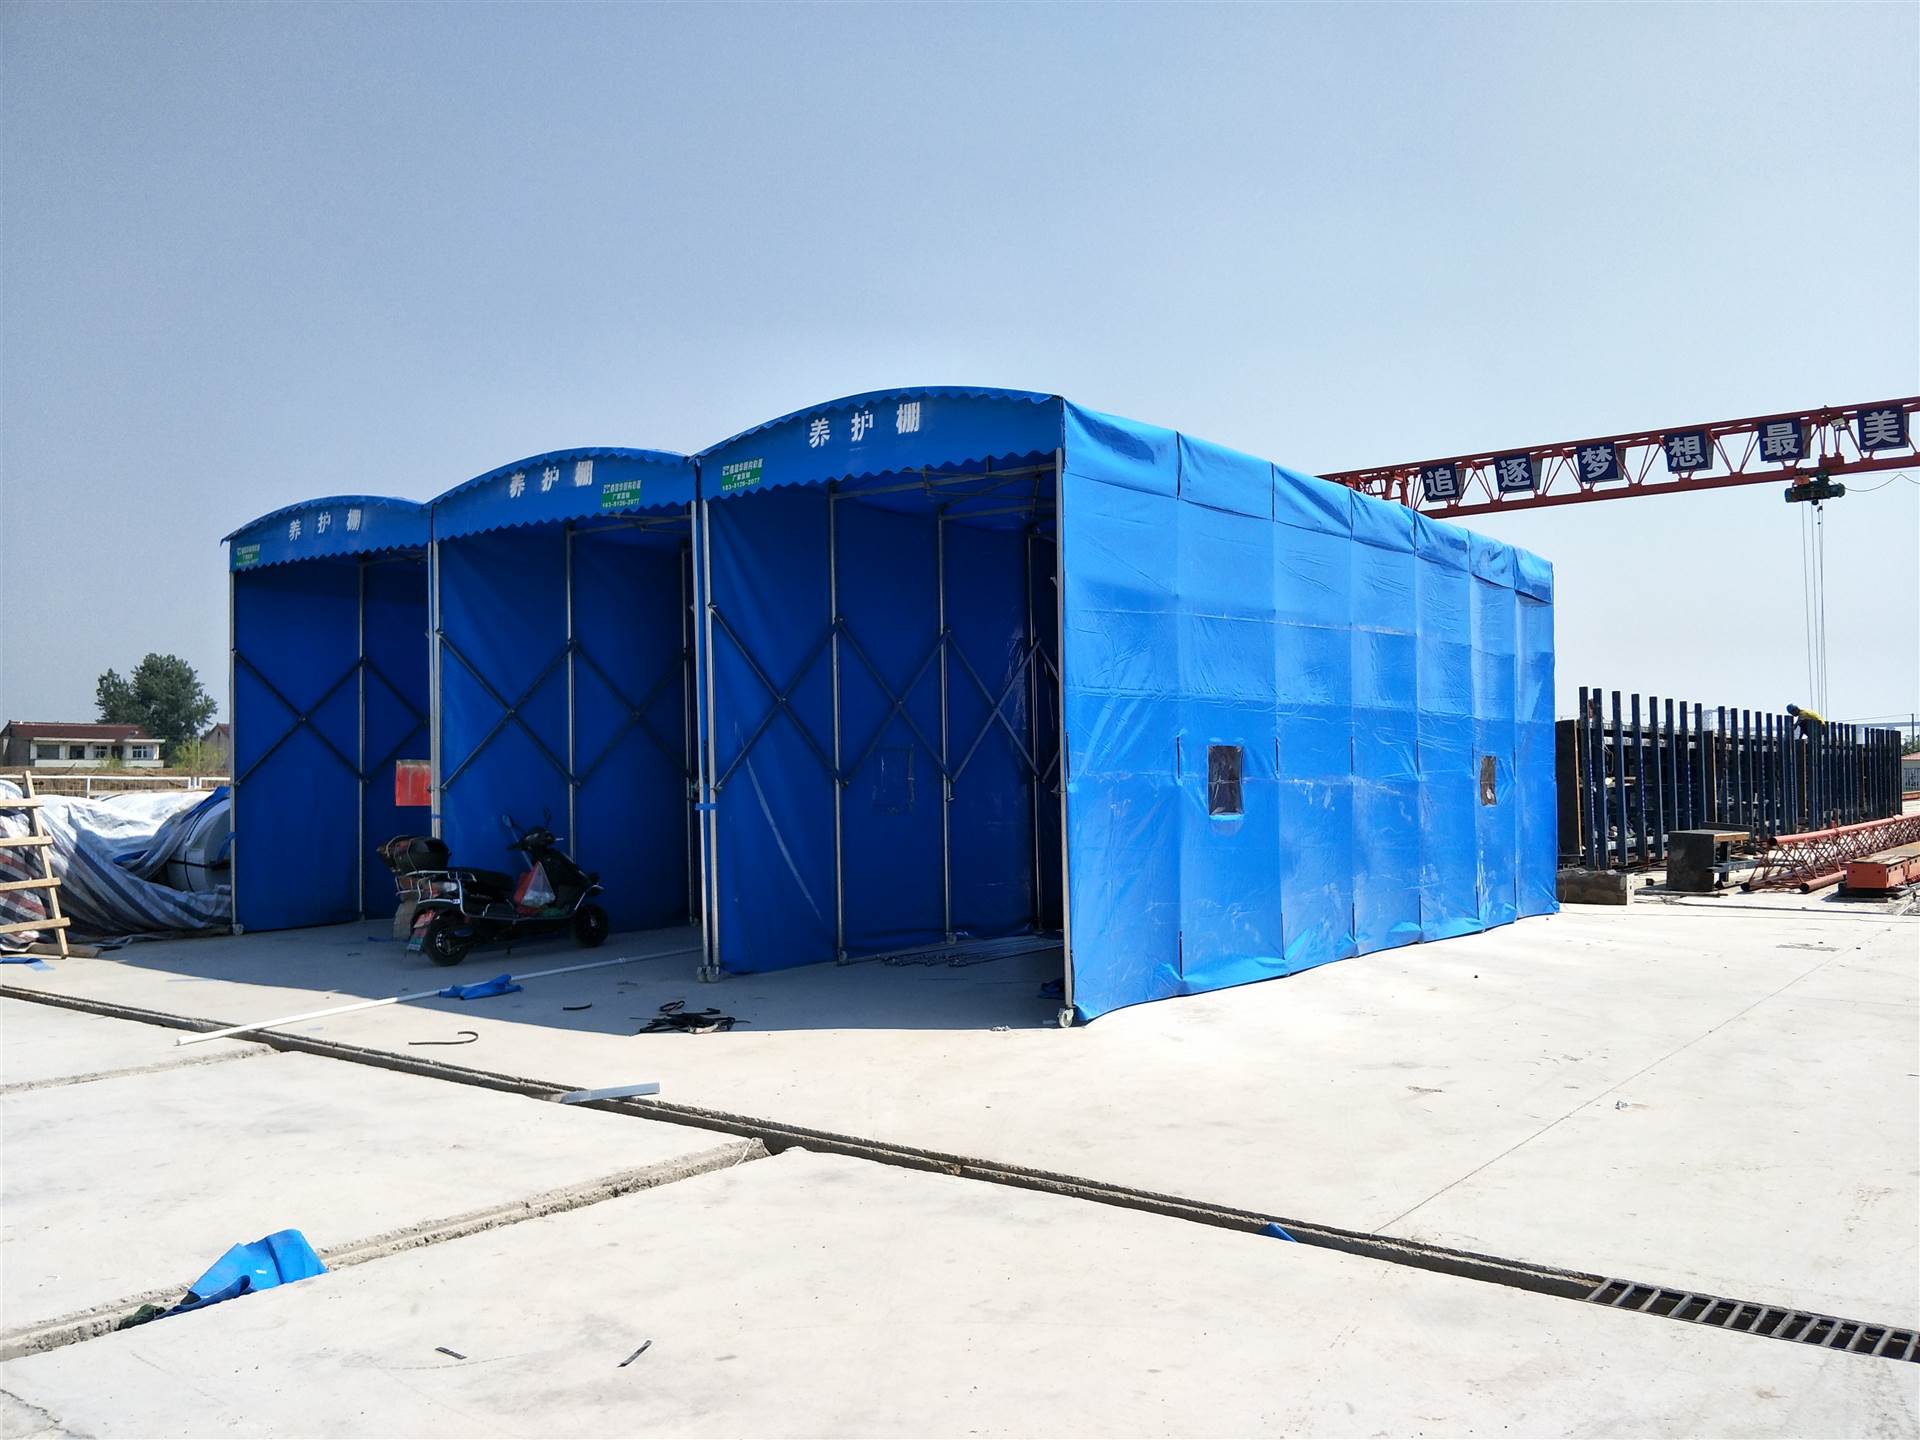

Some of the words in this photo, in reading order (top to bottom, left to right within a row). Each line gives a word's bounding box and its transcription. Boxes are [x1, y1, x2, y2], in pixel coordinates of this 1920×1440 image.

[809, 402, 920, 449] 养护棚
[509, 460, 593, 498] 养护棚
[288, 508, 362, 541] 养护棚
